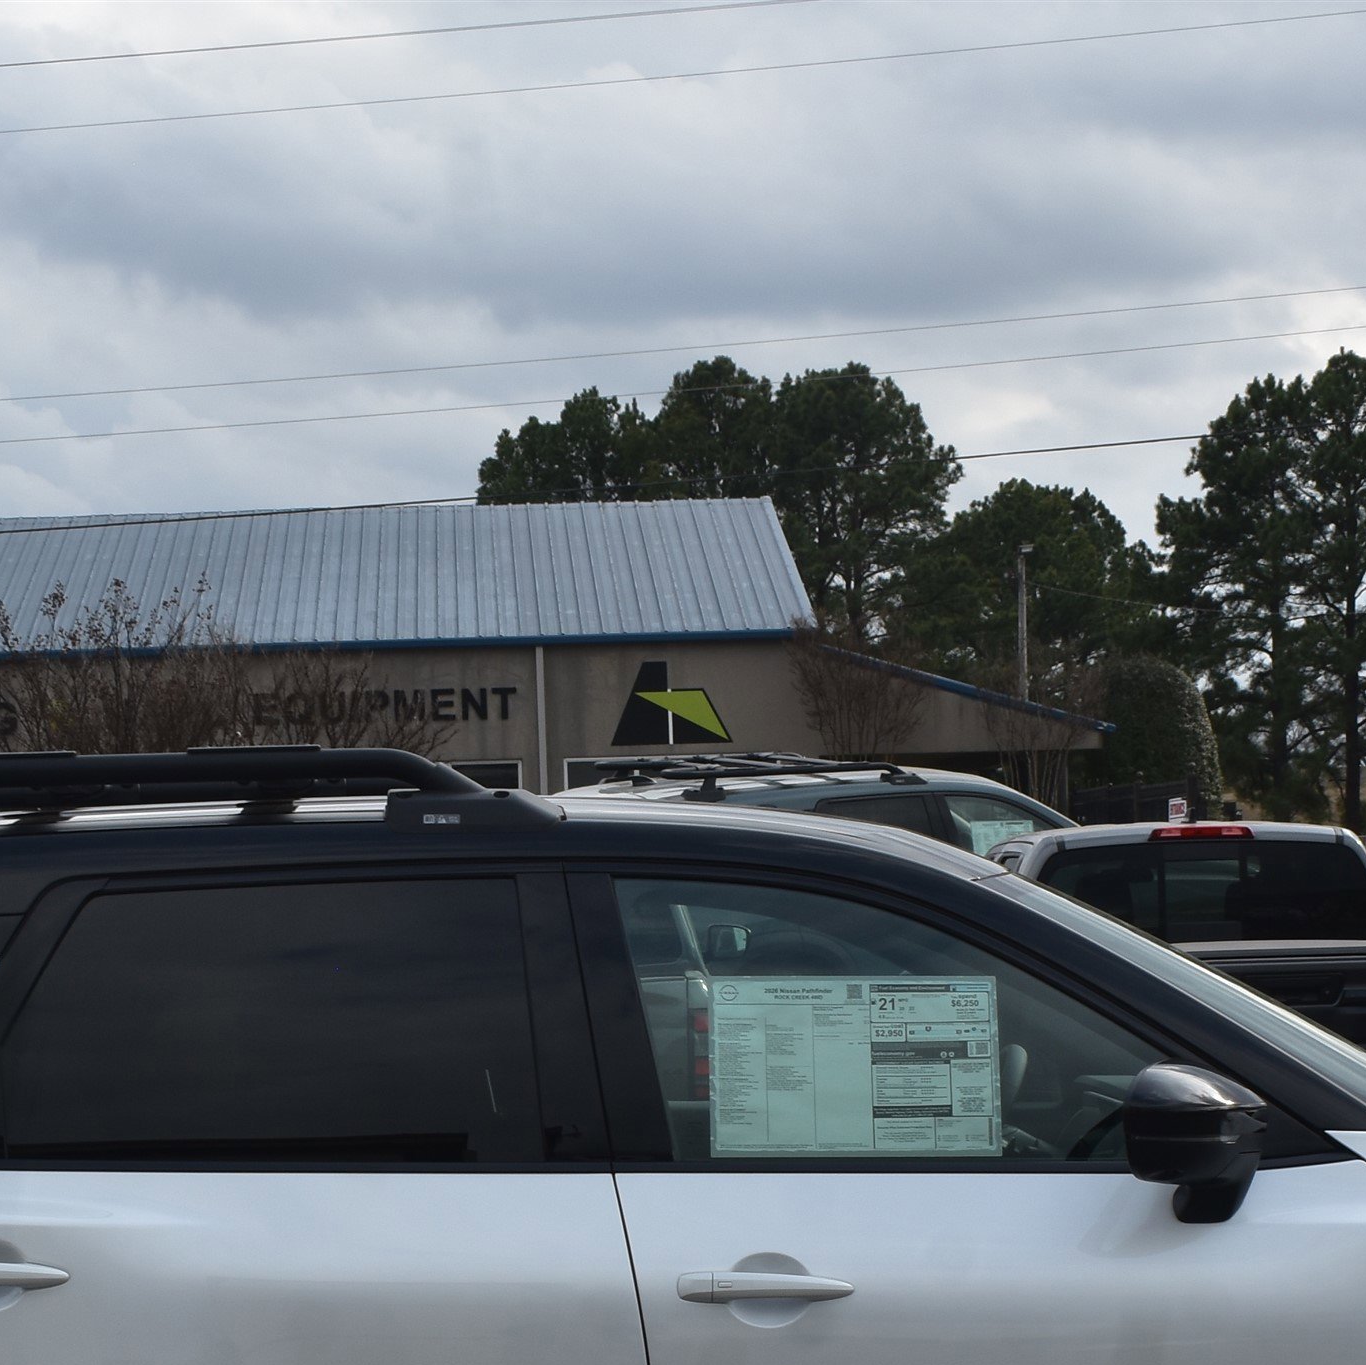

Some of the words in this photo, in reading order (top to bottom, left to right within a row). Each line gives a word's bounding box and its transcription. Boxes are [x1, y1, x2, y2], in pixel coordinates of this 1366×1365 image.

[878, 998, 895, 1010] 21
[951, 999, 979, 1007] $6,250
[875, 1029, 903, 1037] $2,950
